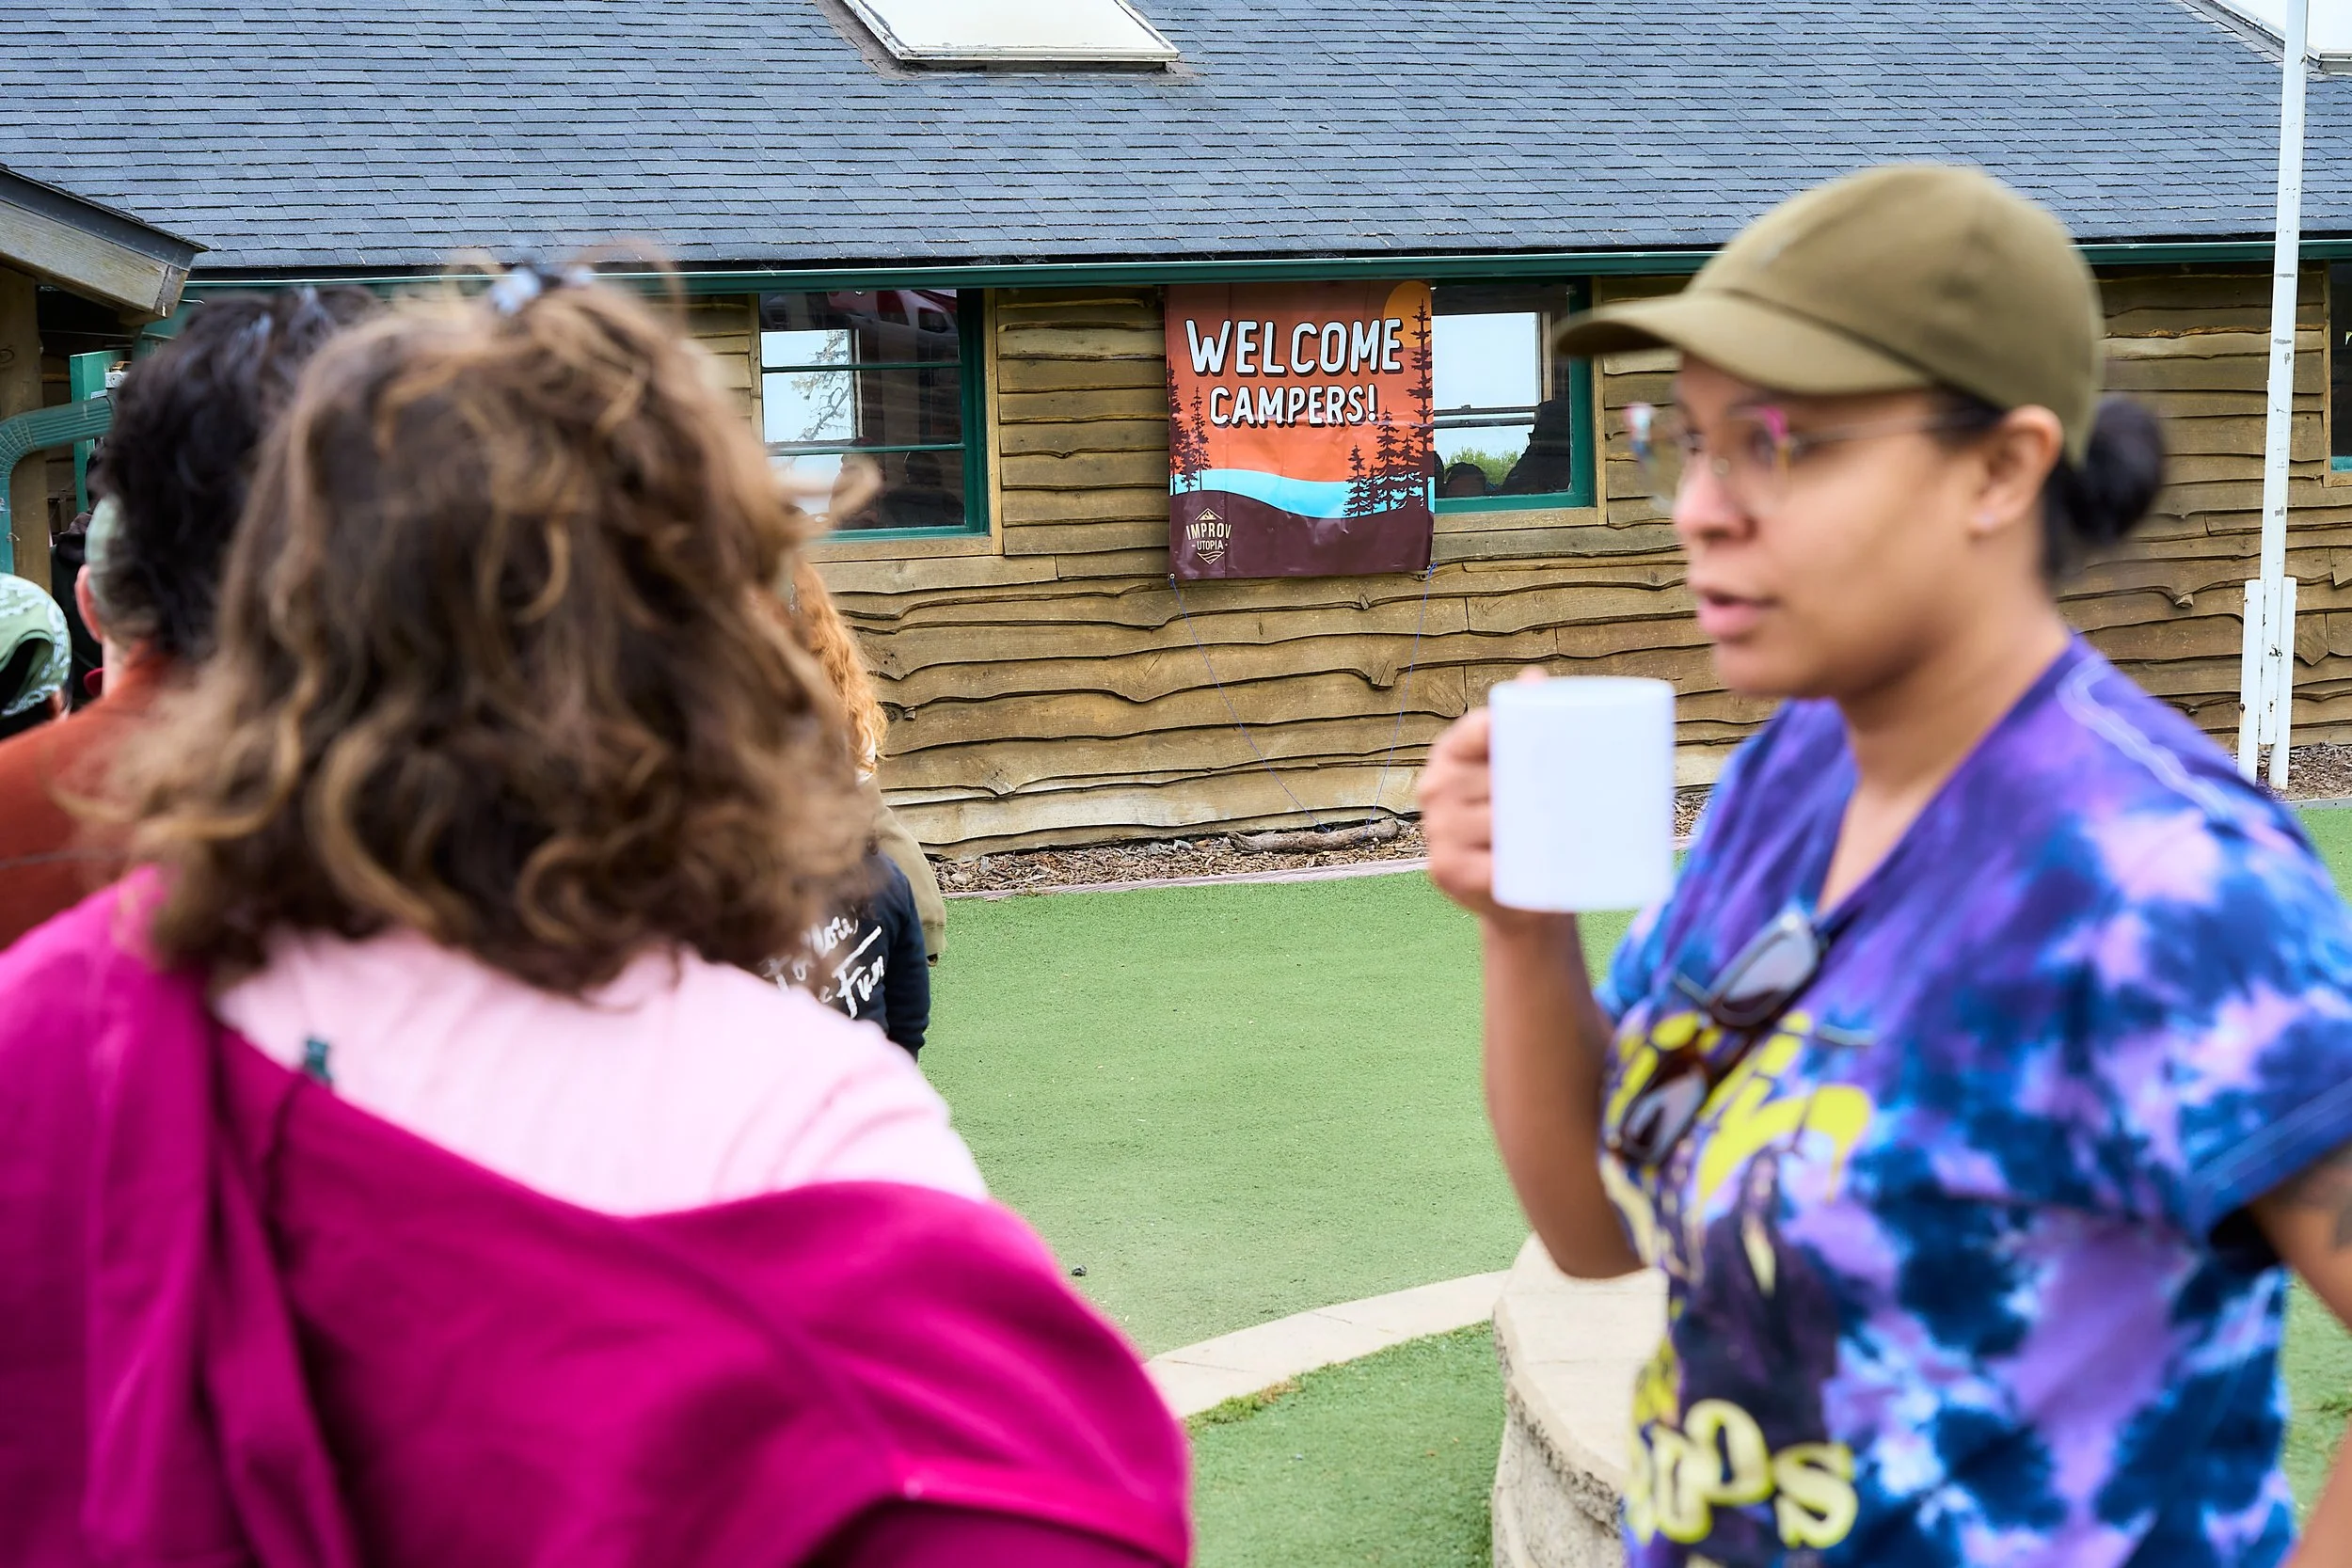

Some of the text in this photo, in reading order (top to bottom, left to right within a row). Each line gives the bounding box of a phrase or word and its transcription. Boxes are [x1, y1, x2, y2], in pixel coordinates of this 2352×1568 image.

[1184, 318, 1403, 375] WELCOME
[1209, 383, 1377, 426] CAMPERS!
[1185, 522, 1232, 541] IMPROV
[1196, 539, 1224, 551] UTOPIA
